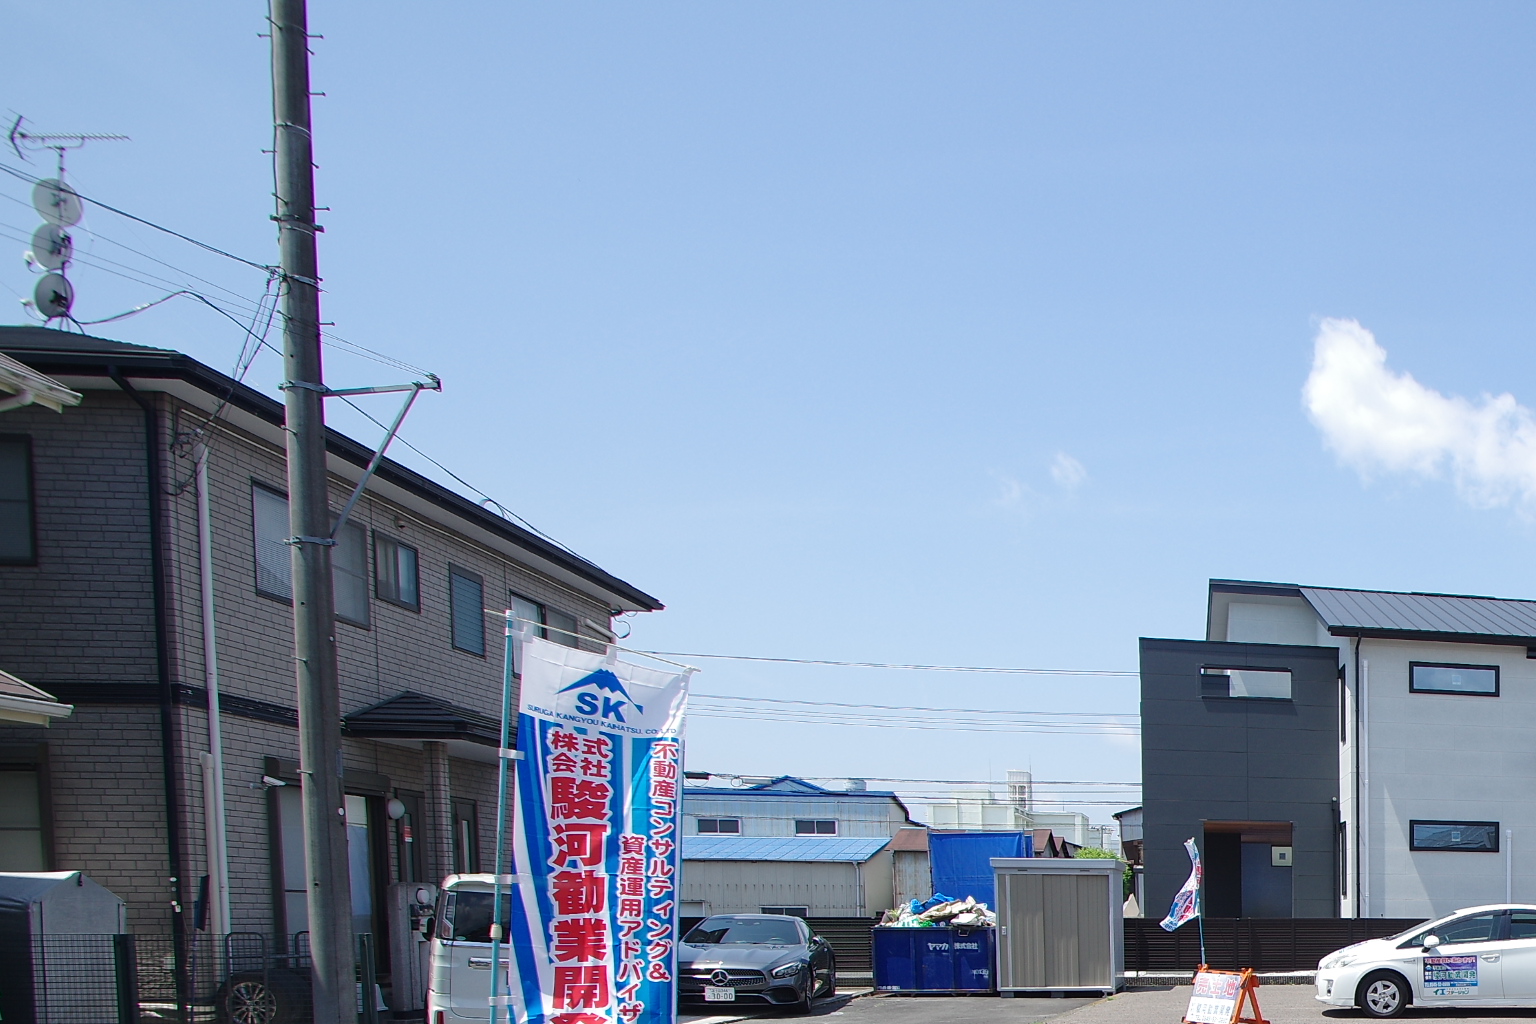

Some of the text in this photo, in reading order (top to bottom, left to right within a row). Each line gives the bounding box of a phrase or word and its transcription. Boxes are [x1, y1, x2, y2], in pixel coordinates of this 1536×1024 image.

[527, 703, 555, 717] SURUGA
[556, 712, 599, 726] KANGYOU
[575, 692, 627, 723] SK
[1196, 977, 1237, 997] 売土地
